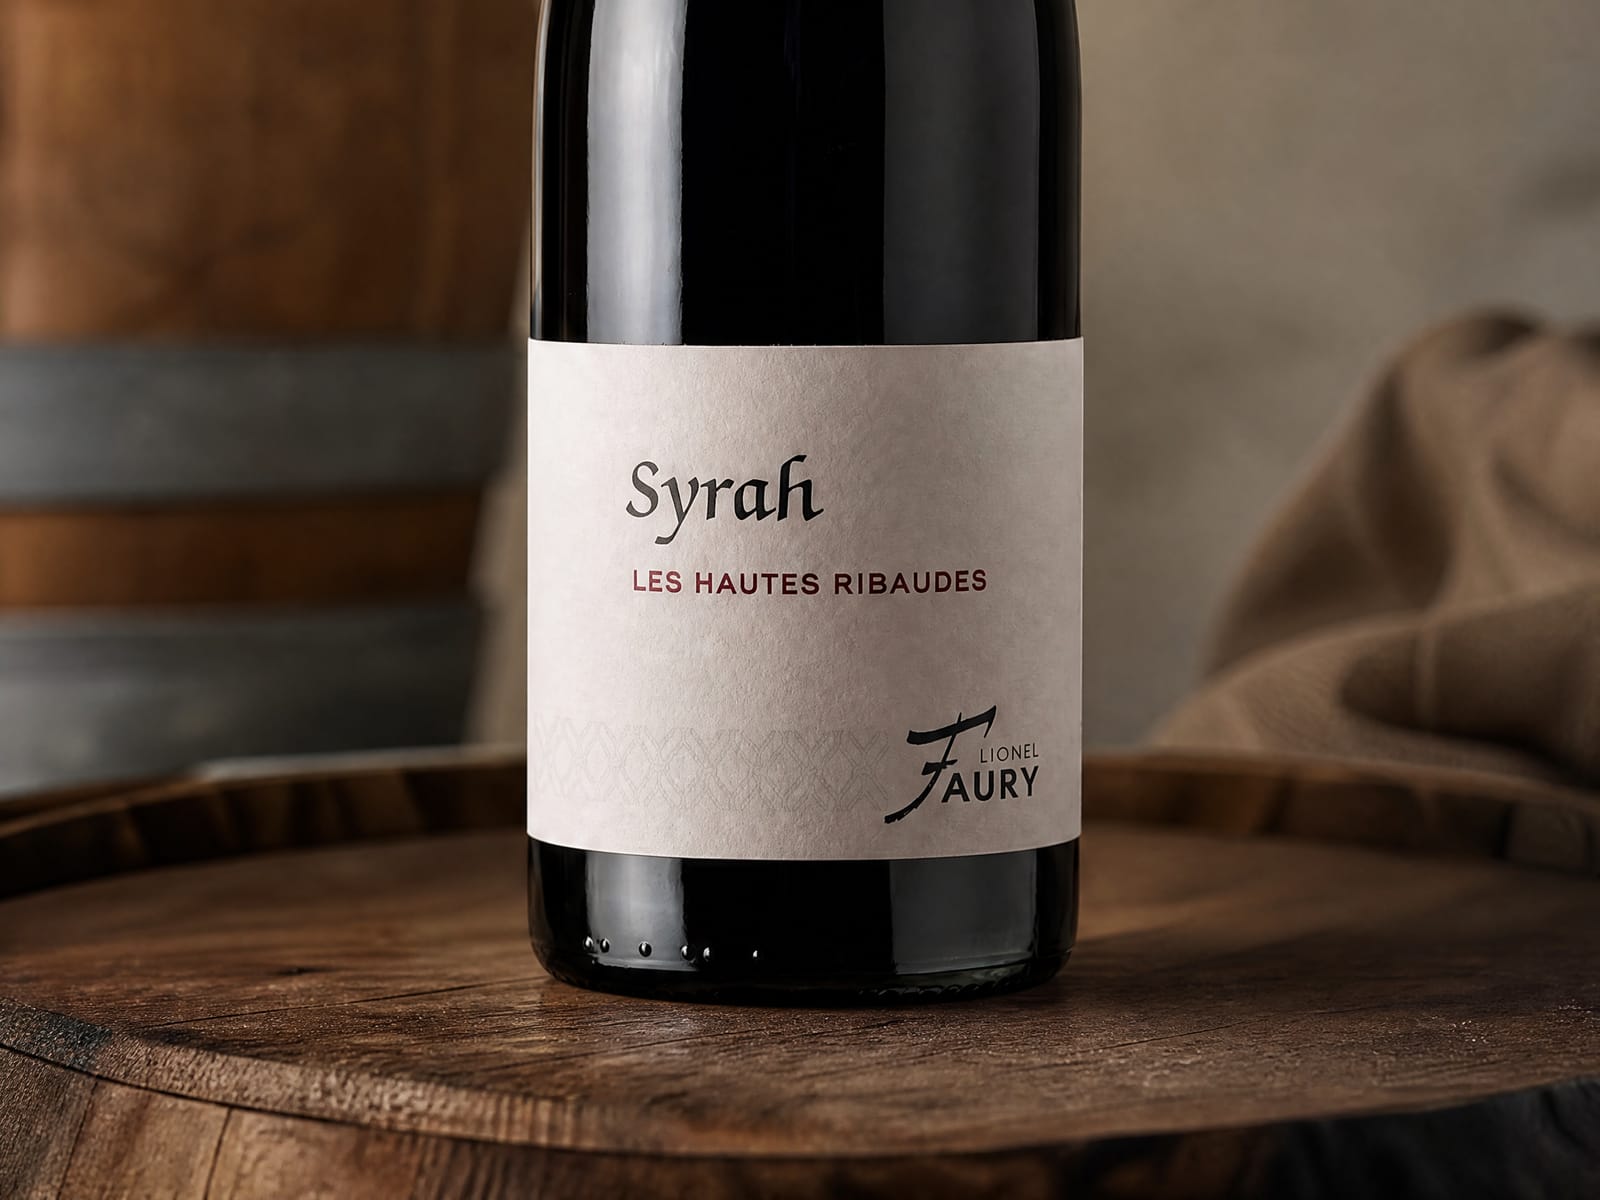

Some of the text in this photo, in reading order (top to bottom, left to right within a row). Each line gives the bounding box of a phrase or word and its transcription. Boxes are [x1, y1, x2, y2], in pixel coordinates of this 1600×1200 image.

[626, 454, 824, 545] Syrah
[633, 569, 988, 596] LES HAUTES RIBAUDES
[884, 704, 1039, 824] FAURY
[980, 742, 1039, 764] LIONEL
